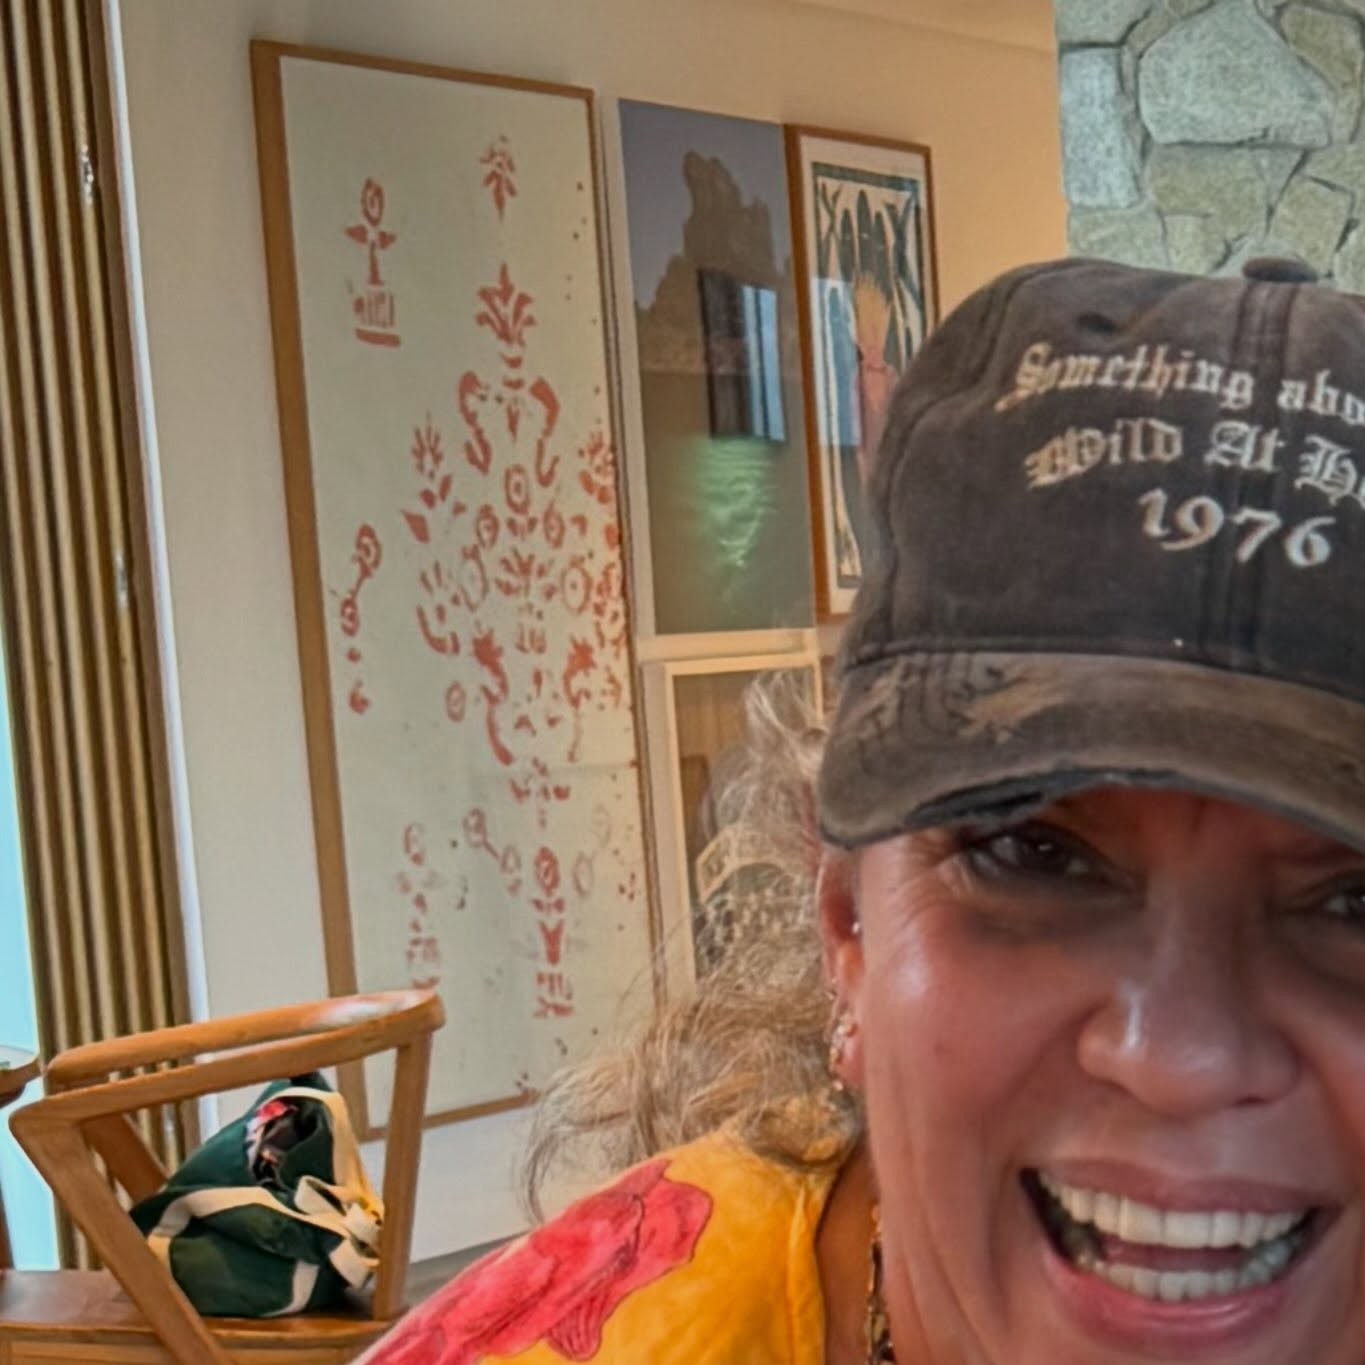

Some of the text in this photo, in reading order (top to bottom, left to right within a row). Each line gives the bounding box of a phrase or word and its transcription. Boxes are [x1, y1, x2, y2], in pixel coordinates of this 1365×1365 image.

[994, 341, 1255, 411] Something
[1024, 416, 1184, 489] Wild
[1202, 419, 1286, 472] At
[1137, 486, 1337, 568] 1976
